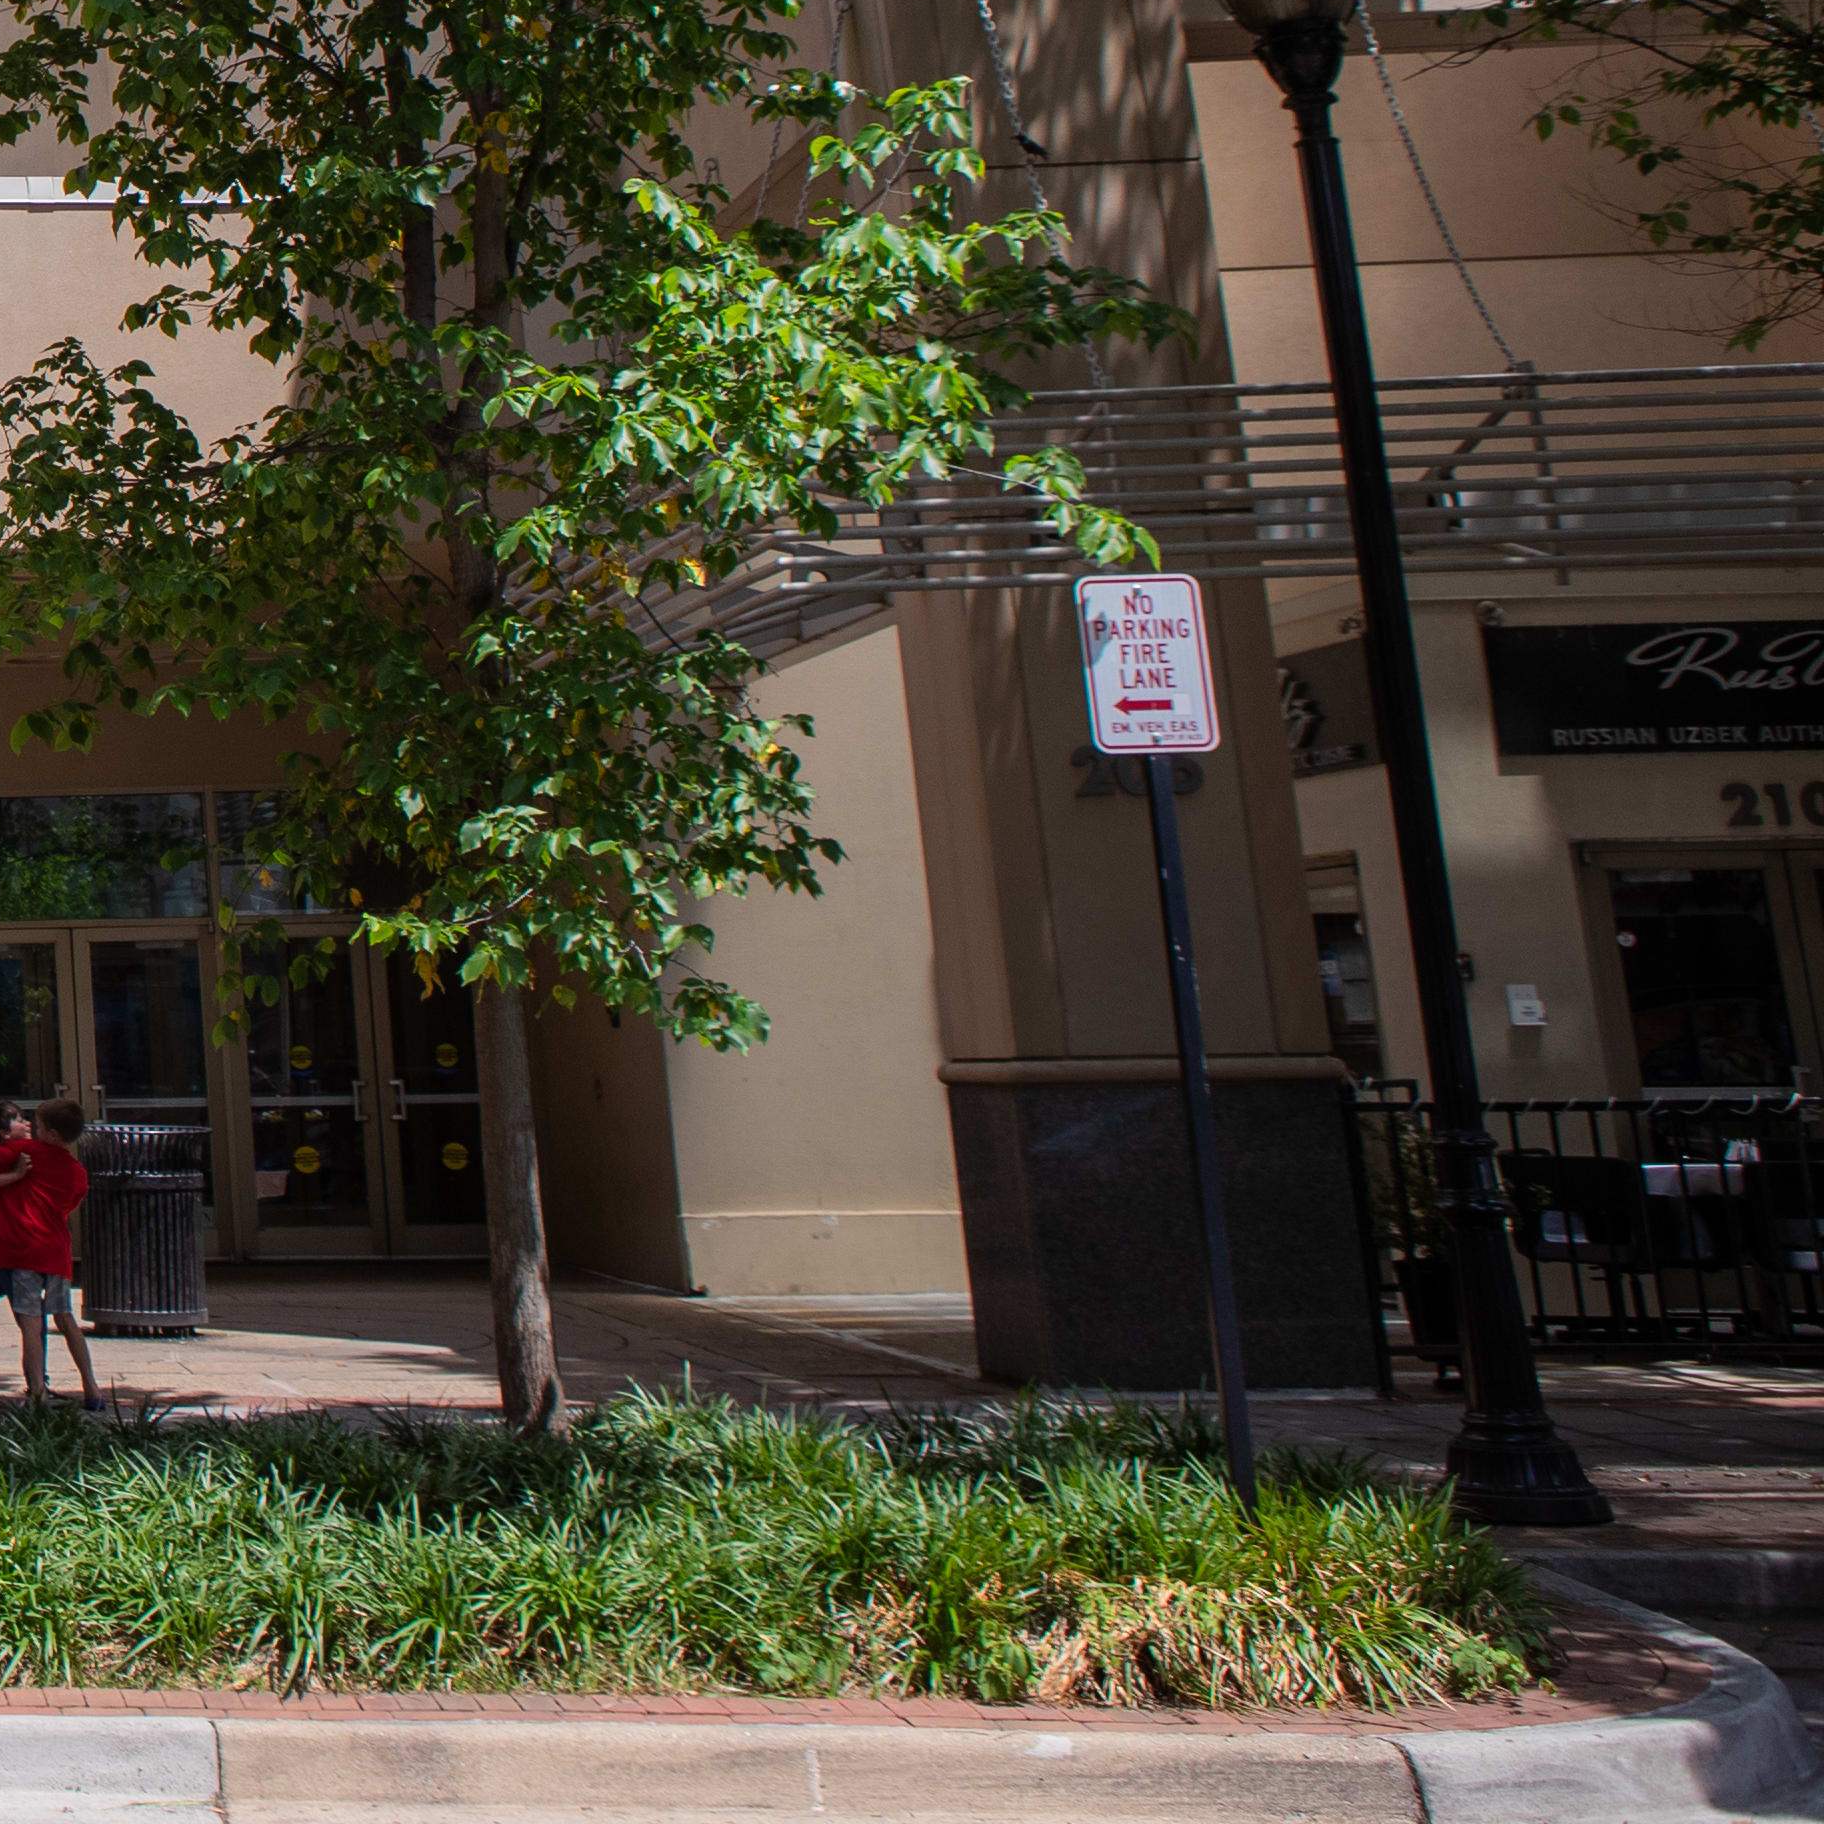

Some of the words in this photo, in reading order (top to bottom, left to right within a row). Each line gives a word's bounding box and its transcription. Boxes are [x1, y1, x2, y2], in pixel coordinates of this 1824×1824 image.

[1123, 595, 1154, 616] NO
[1093, 618, 1191, 641] PARKING
[1120, 643, 1171, 665] FIRE
[1120, 668, 1177, 689] LANE
[1552, 727, 1657, 747] RUSSIAN
[1668, 726, 1749, 745] UZBEK
